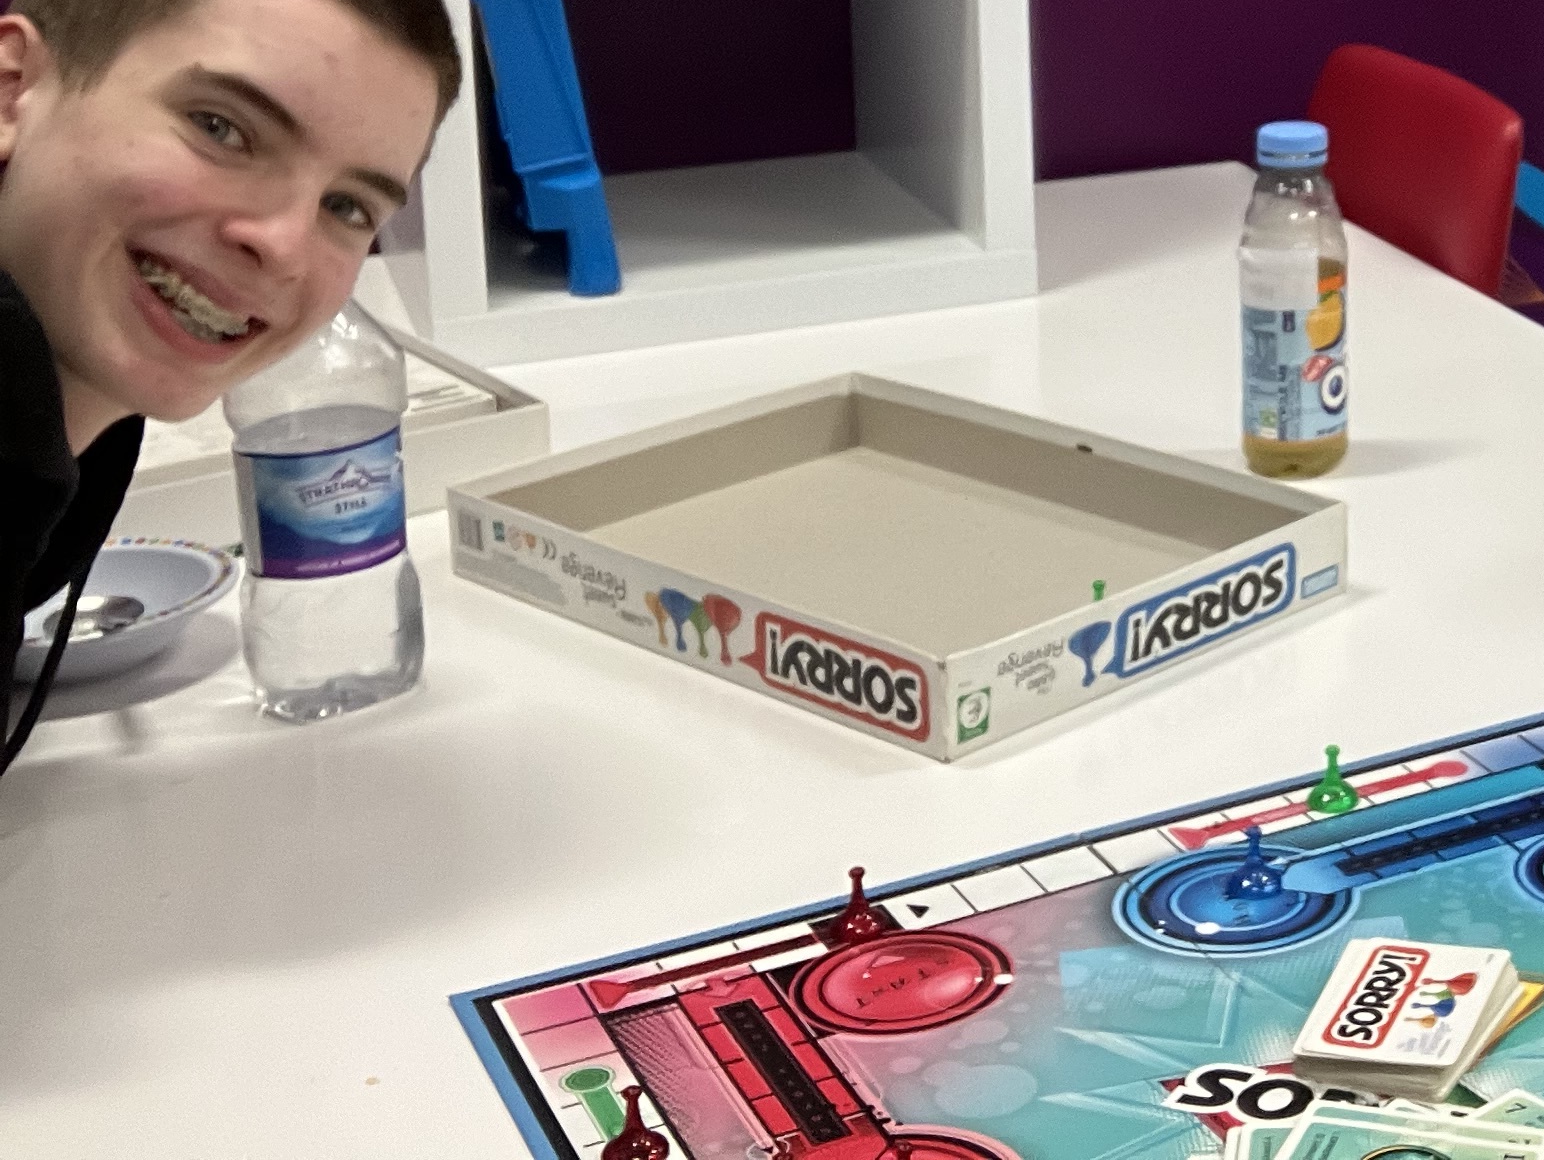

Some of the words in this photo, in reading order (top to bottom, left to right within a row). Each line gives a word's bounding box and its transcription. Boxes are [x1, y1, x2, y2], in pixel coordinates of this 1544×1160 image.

[1129, 557, 1285, 662] SORRY!
[769, 626, 920, 724] SORRY!
[1338, 953, 1418, 1043] SORRY!
